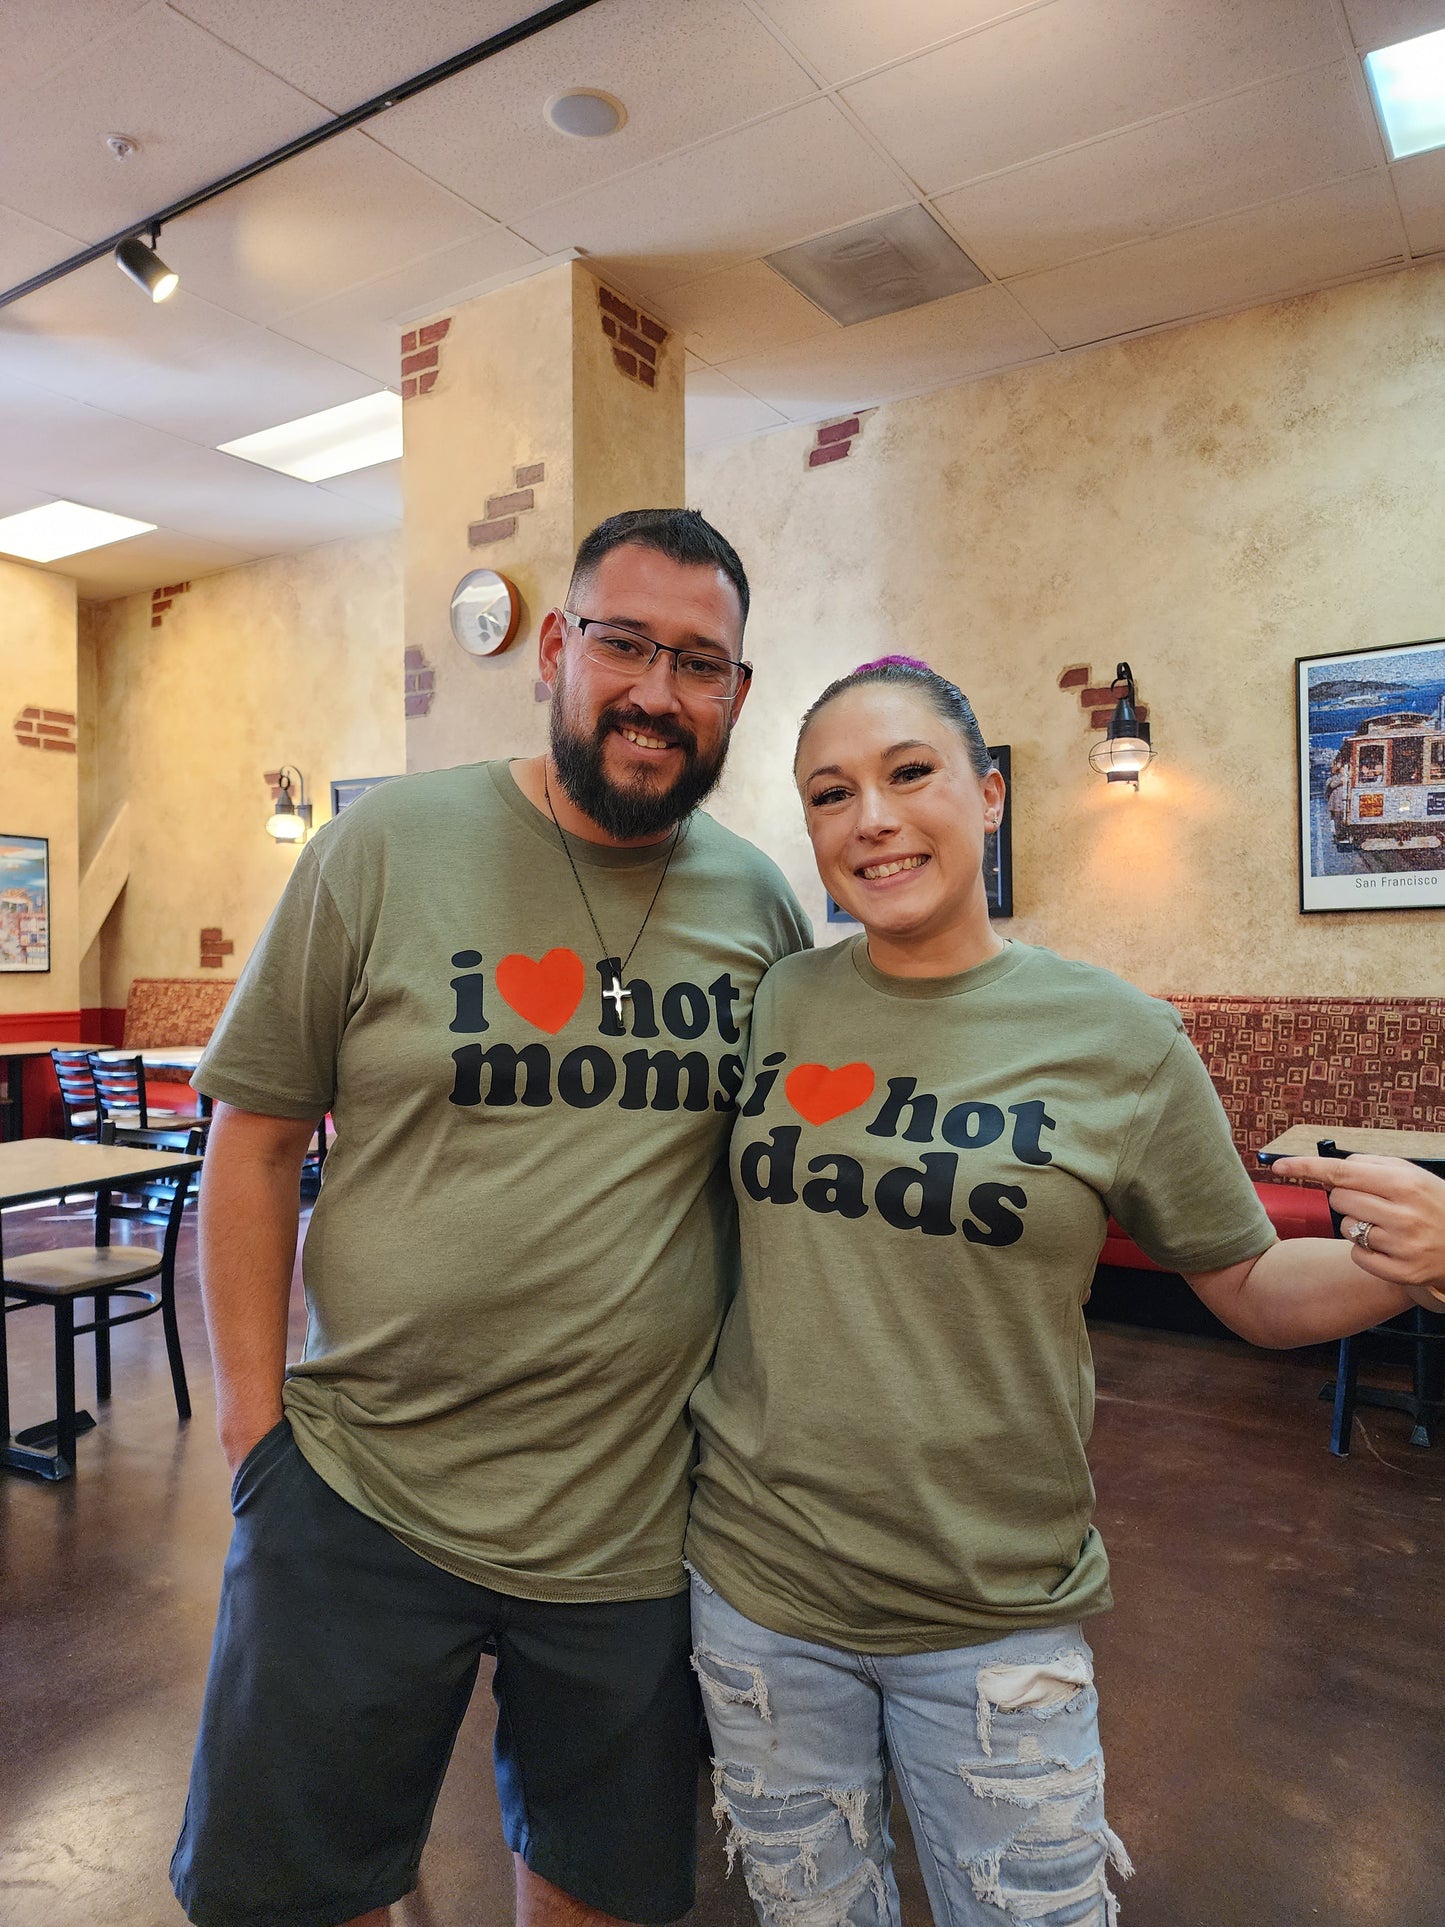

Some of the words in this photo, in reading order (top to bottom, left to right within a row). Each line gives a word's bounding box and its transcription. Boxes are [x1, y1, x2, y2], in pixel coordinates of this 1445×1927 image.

[1355, 878, 1377, 889] San
[1381, 875, 1438, 888] Francisco
[449, 949, 489, 1034] i
[596, 957, 741, 1045] hot
[449, 1043, 744, 1112] moms
[742, 1051, 787, 1117] i
[865, 1077, 1057, 1166] hot
[741, 1125, 1028, 1247] dads
